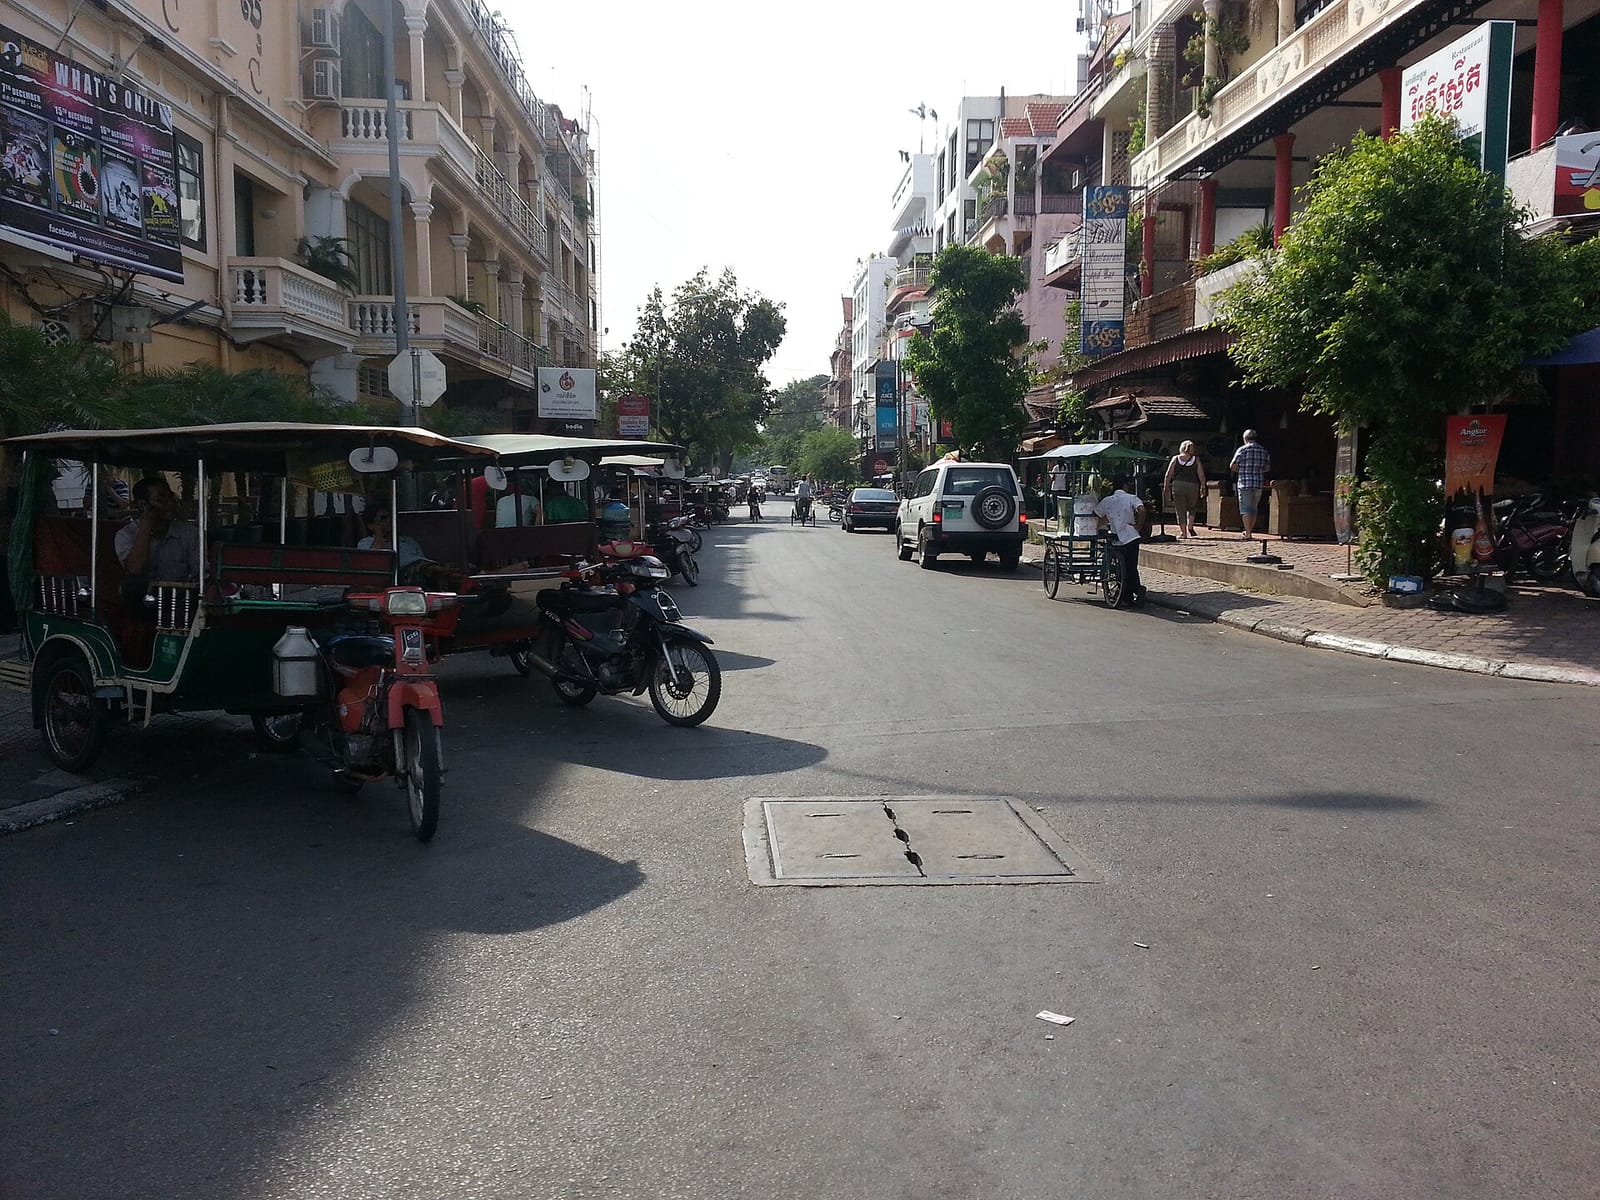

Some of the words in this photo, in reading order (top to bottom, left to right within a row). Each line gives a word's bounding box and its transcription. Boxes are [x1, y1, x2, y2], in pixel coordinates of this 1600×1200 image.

[1451, 35, 1484, 60] Restaurant
[55, 61, 117, 104] WHAT'S
[11, 87, 41, 103] DECEMBER
[67, 111, 94, 125] DECEMBER
[49, 223, 77, 239] facebook
[1459, 428, 1488, 437] Angkor
